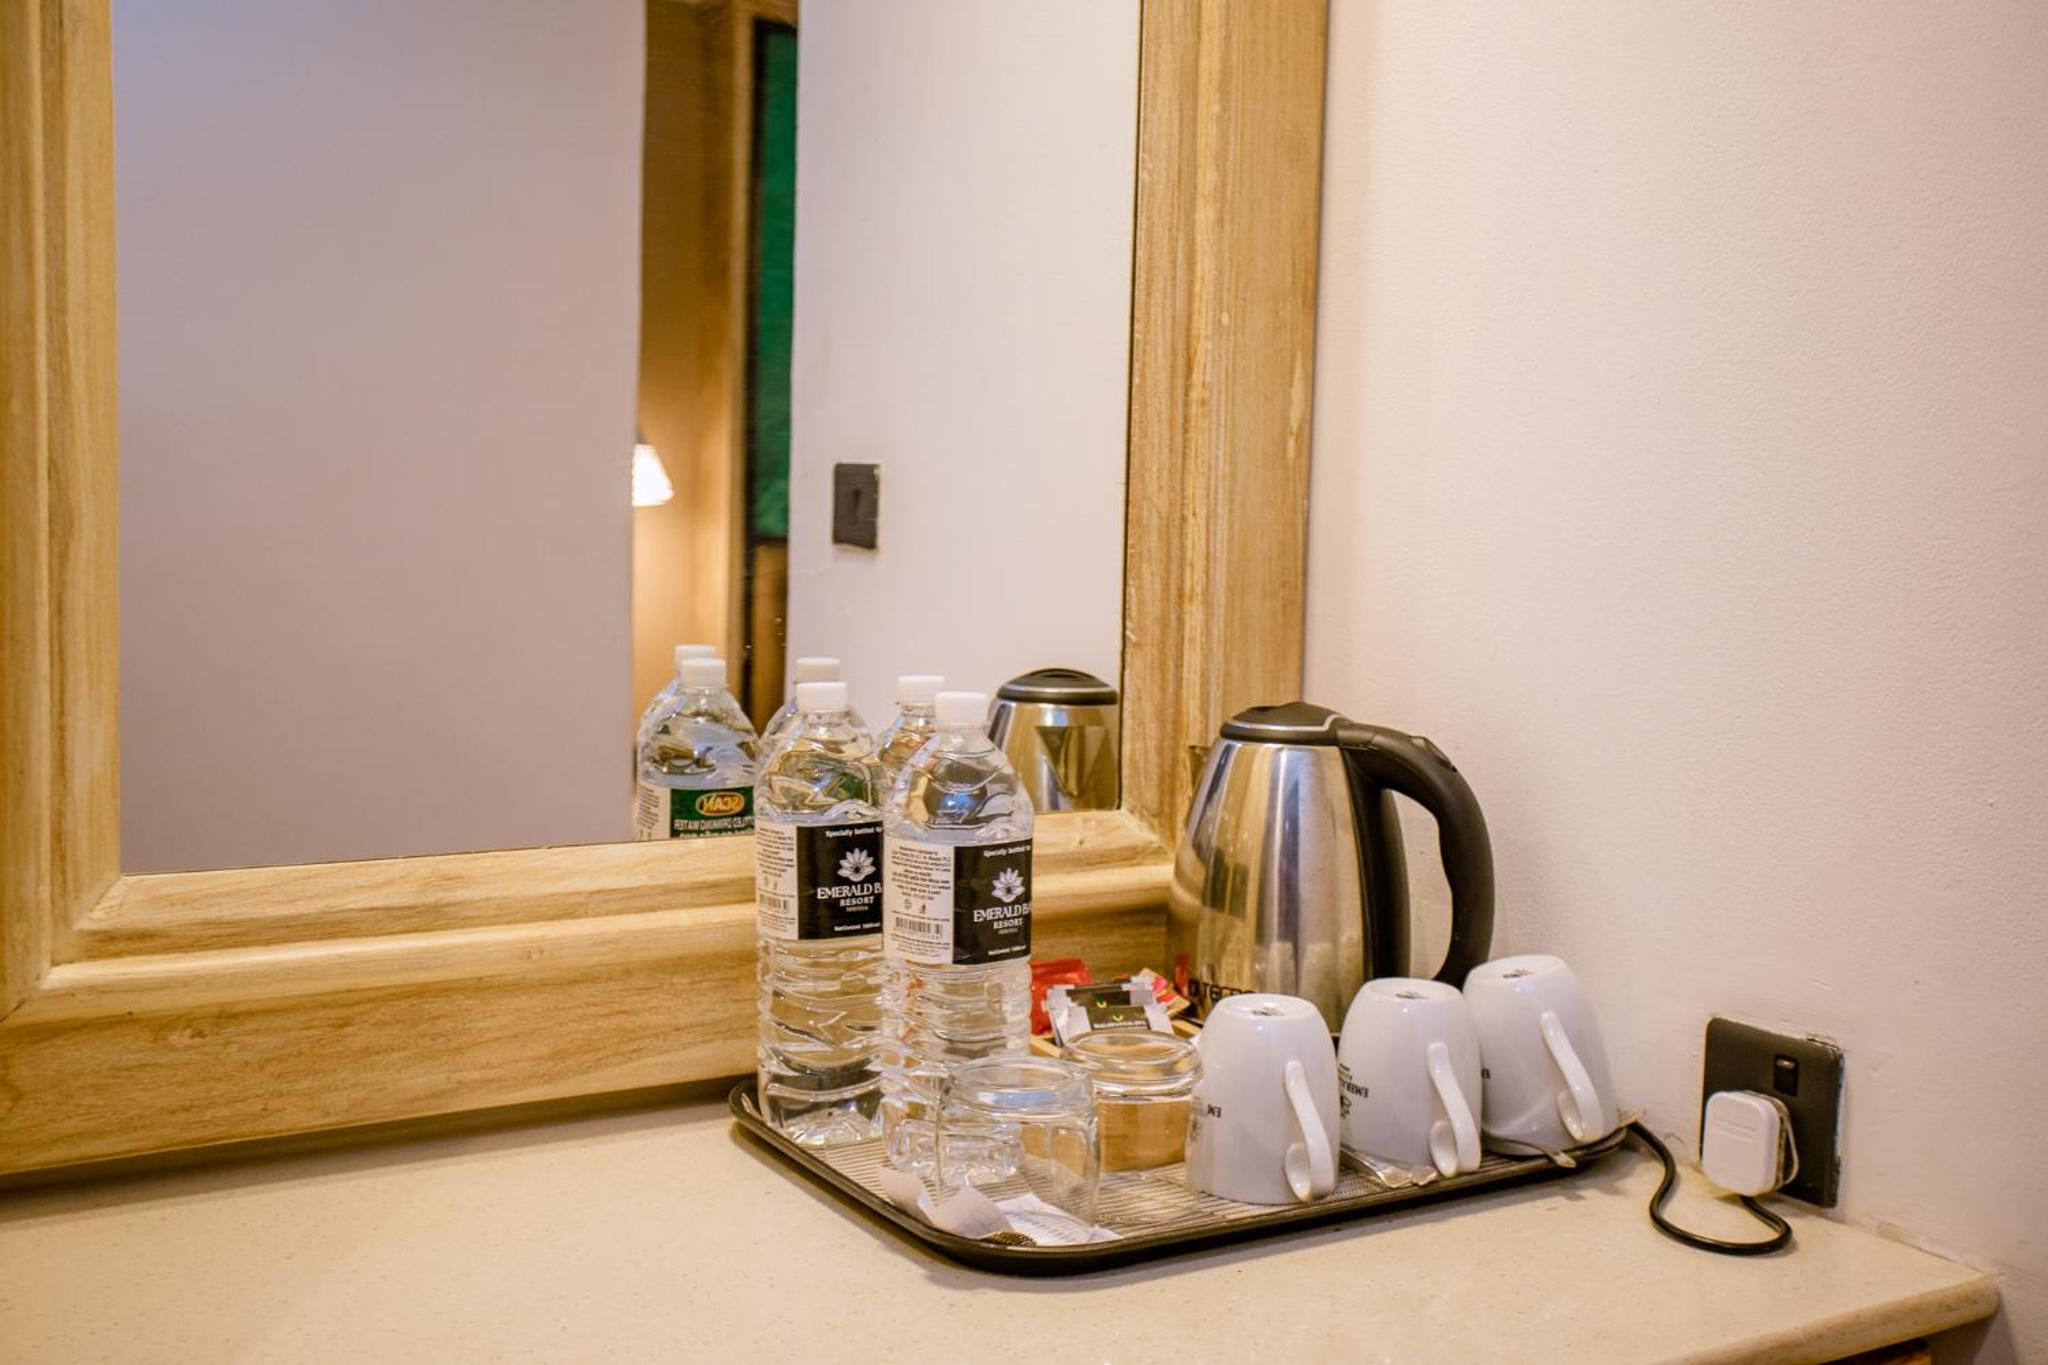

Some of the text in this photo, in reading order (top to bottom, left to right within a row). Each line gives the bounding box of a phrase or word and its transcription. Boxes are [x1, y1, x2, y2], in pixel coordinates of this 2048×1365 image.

[817, 882, 883, 899] EMERALD B
[840, 895, 874, 906] RESORT
[973, 904, 1021, 922] EMERALD
[993, 917, 1023, 929] RESORT
